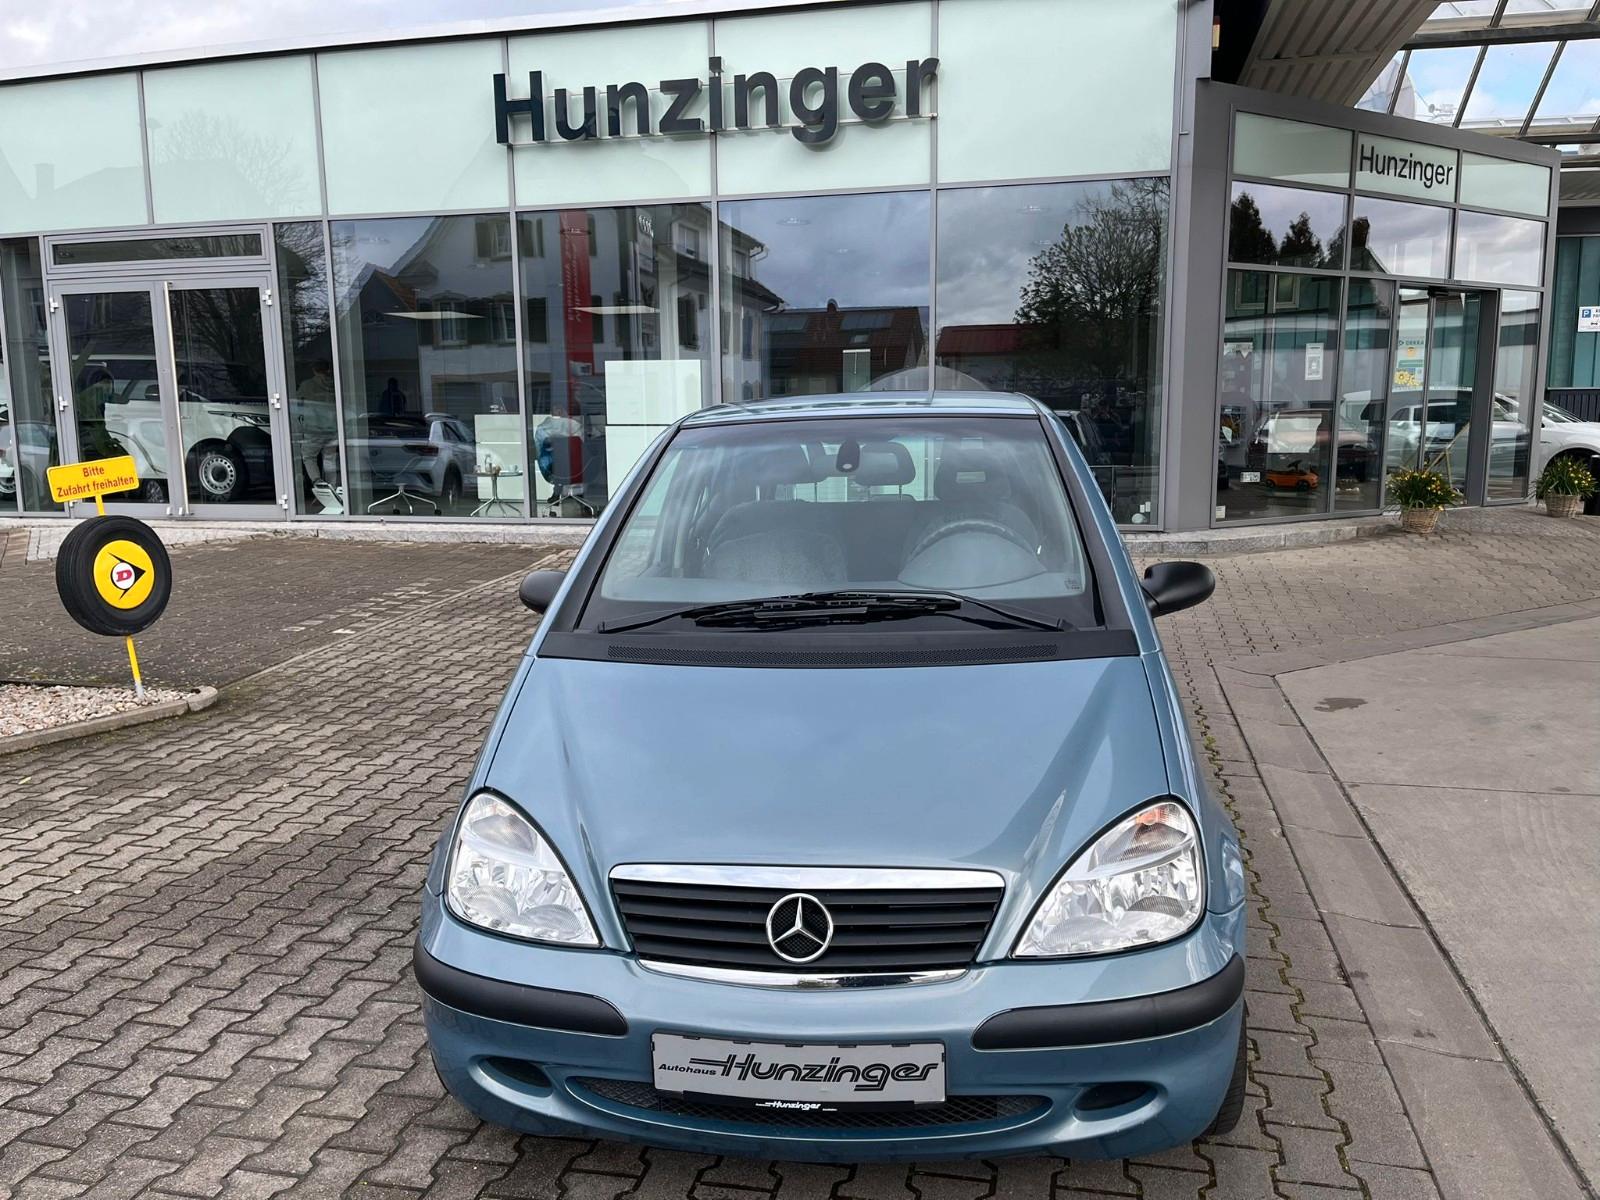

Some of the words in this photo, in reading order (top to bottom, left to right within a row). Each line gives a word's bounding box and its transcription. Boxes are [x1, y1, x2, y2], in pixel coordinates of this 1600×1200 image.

[493, 56, 940, 145] Hunzinger
[1360, 144, 1453, 189] Hunzinger
[82, 465, 105, 478] Bitte
[56, 483, 92, 498] Zufahrt
[92, 476, 135, 492] freihalten
[115, 569, 133, 583] D
[658, 1062, 717, 1076] Autohaus
[688, 1053, 939, 1092] Hunzinger
[764, 1101, 822, 1111] Hunzinger
